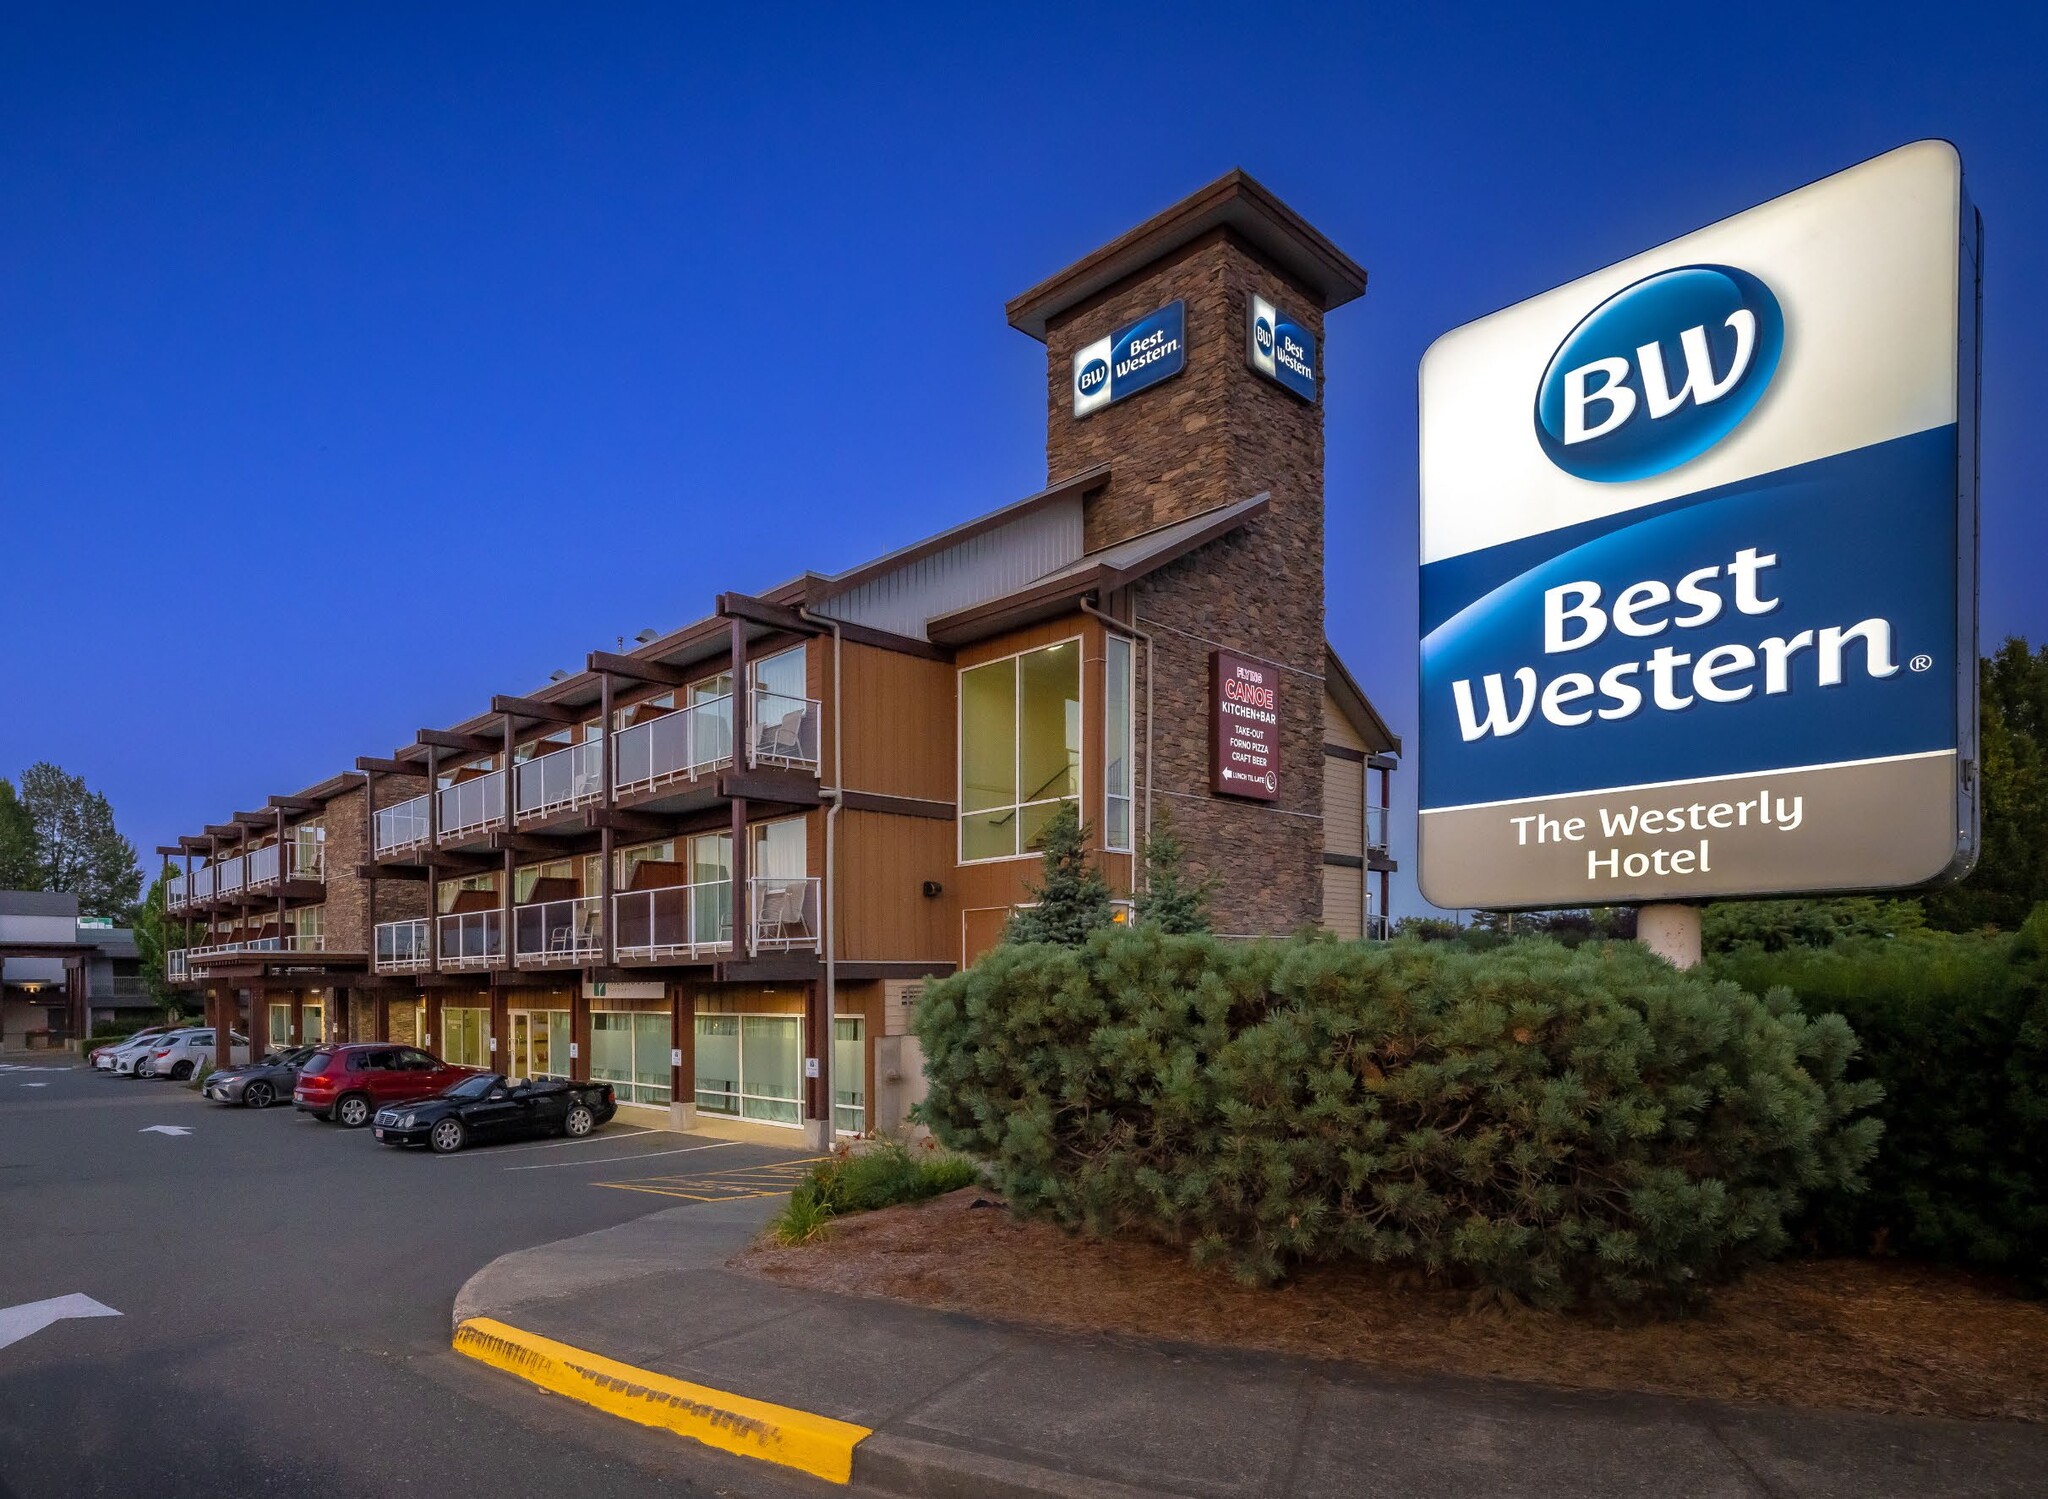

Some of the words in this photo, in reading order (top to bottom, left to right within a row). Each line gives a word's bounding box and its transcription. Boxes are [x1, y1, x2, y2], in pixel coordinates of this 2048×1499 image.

[1130, 329, 1164, 357] Best
[1257, 325, 1272, 348] BW
[1285, 336, 1304, 361] Best
[1115, 338, 1178, 378] Western
[1277, 346, 1312, 380] Western
[1081, 365, 1106, 390] BW
[1563, 309, 1756, 445] BW
[1543, 547, 1779, 655] Best
[1236, 667, 1263, 683] FLYING
[1452, 618, 1900, 742] Western
[1225, 678, 1274, 710] CANOE
[1222, 701, 1276, 724] KITCHEN+BAR
[1235, 725, 1264, 739] TAKE-OUT
[1230, 737, 1251, 750] FORNO
[1251, 742, 1269, 754] PIZZA
[1231, 752, 1251, 763] CRAFT
[1252, 756, 1267, 766] BEER
[1232, 771, 1247, 781] LUNCH
[1254, 775, 1265, 784] LATE
[1510, 815, 1586, 846] The
[1598, 790, 1804, 840] Westerly
[1587, 840, 1711, 880] Hotel
